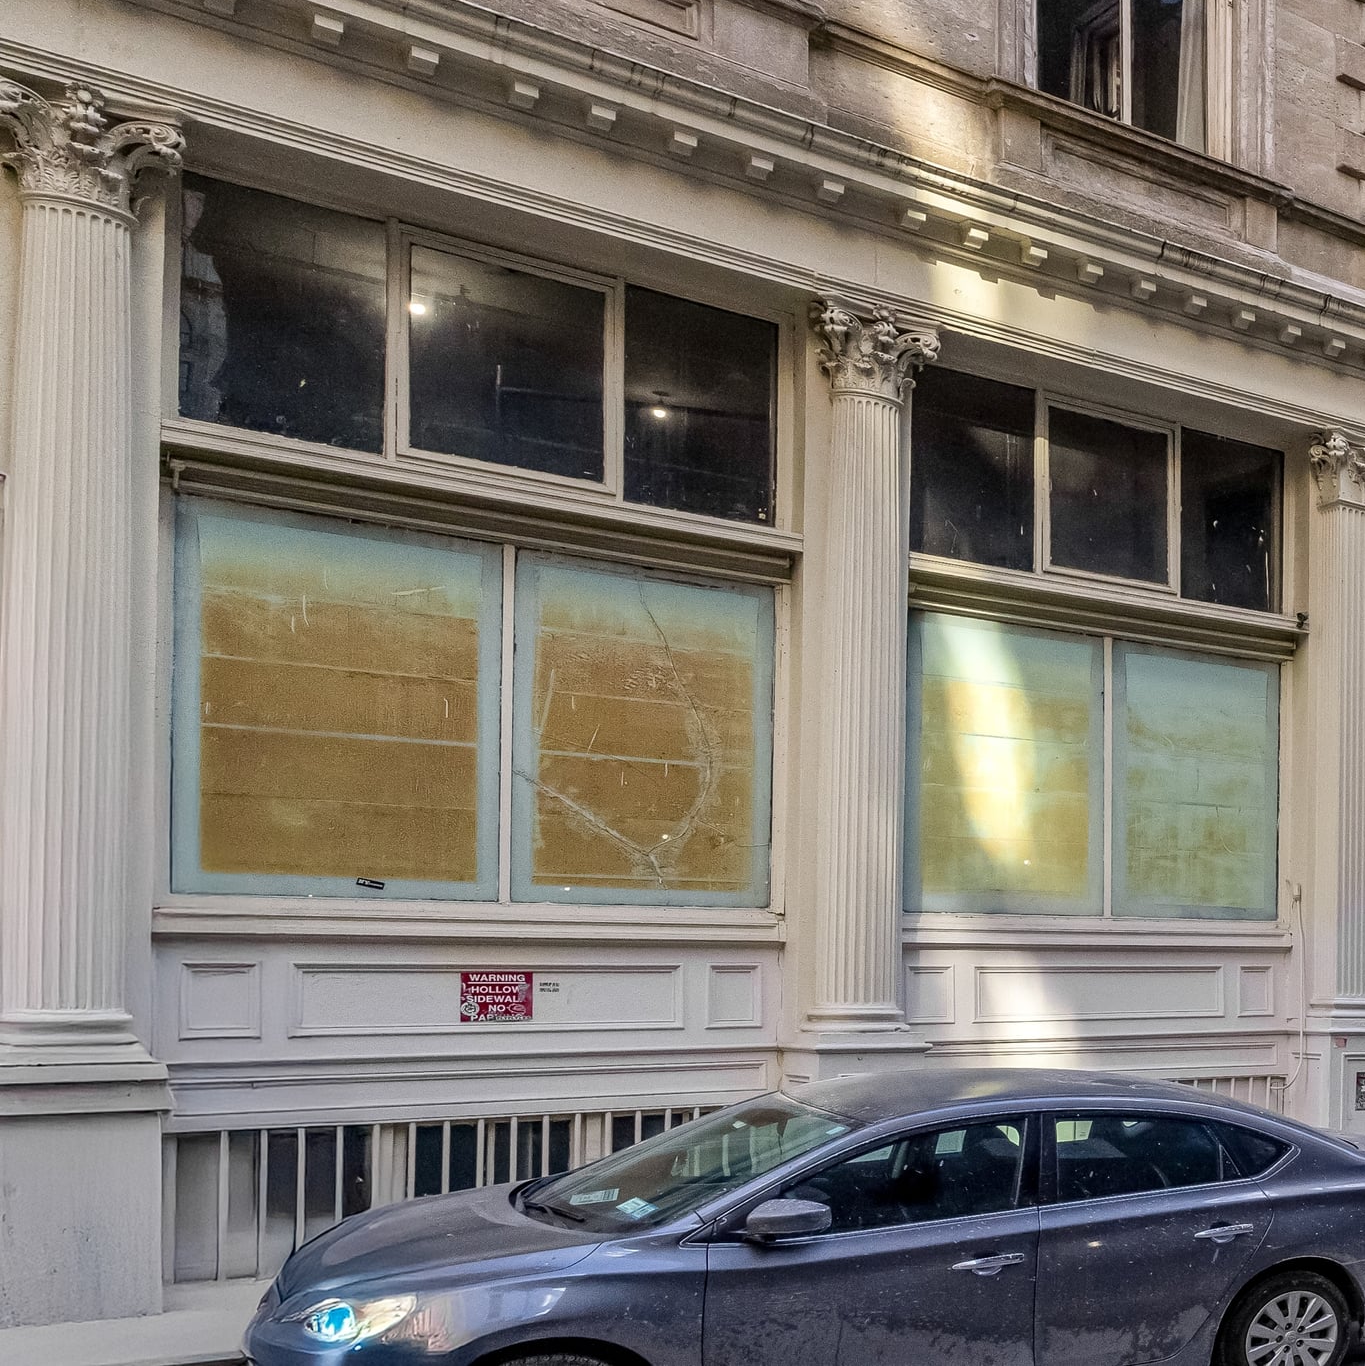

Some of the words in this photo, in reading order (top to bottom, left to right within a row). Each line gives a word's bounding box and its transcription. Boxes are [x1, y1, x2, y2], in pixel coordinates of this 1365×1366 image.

[469, 974, 526, 982] WARNING
[466, 995, 524, 1003] SIDEWAL
[488, 1004, 506, 1012] NO
